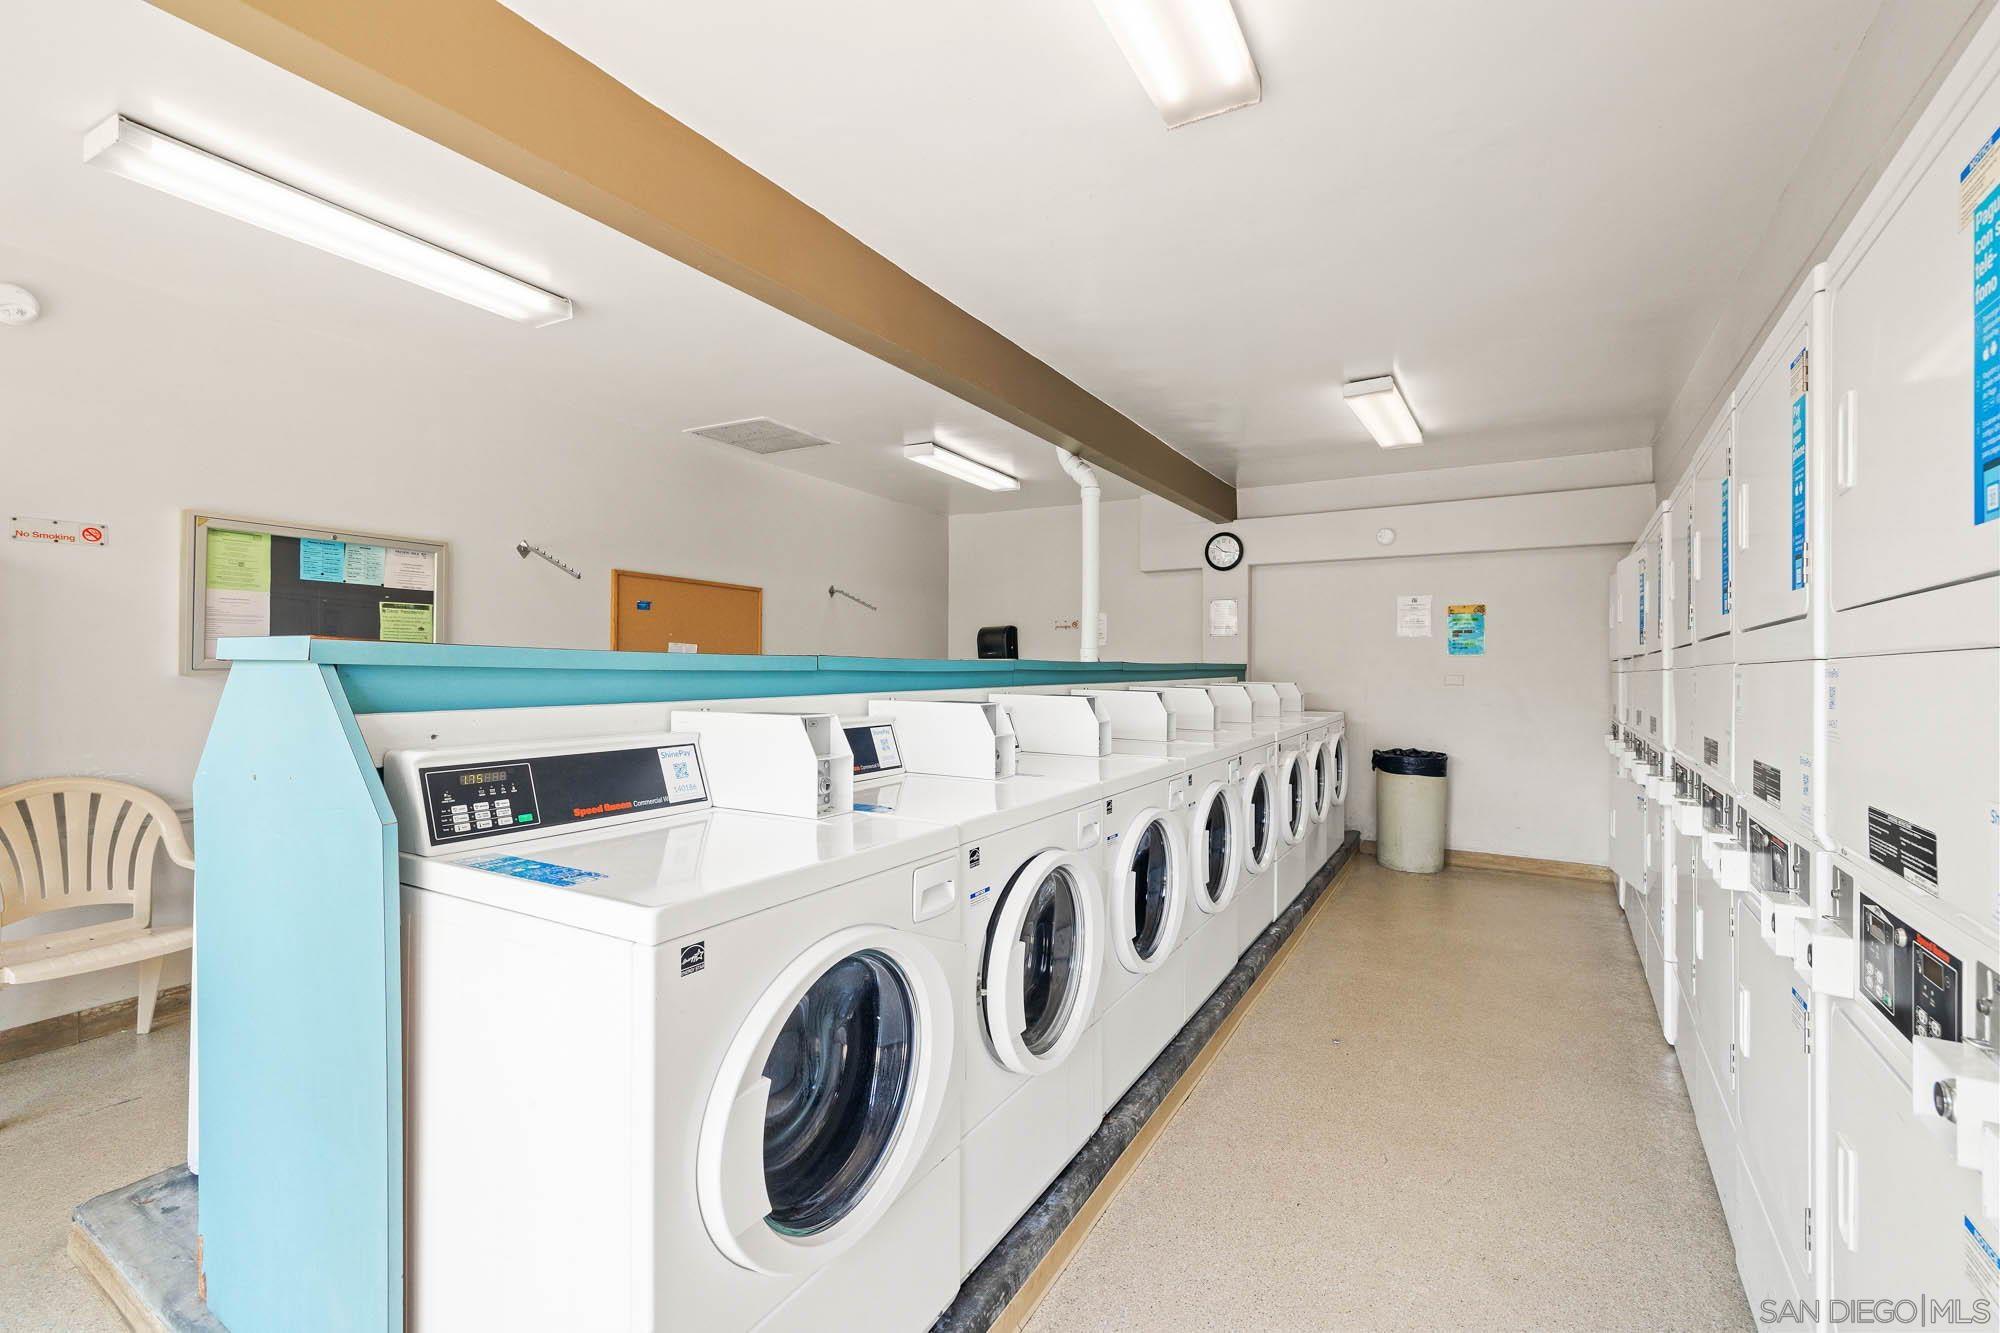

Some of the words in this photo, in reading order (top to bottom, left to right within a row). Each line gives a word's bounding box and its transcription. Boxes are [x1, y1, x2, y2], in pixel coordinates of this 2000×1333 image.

[1975, 229, 1993, 255] con
[1975, 275, 1998, 305] fono
[15, 529, 30, 538] No
[32, 531, 76, 542] Smoking
[660, 749, 691, 759] ShinePay
[573, 804, 604, 818] Speed
[604, 800, 633, 812] Queen
[633, 796, 662, 807] Commercial
